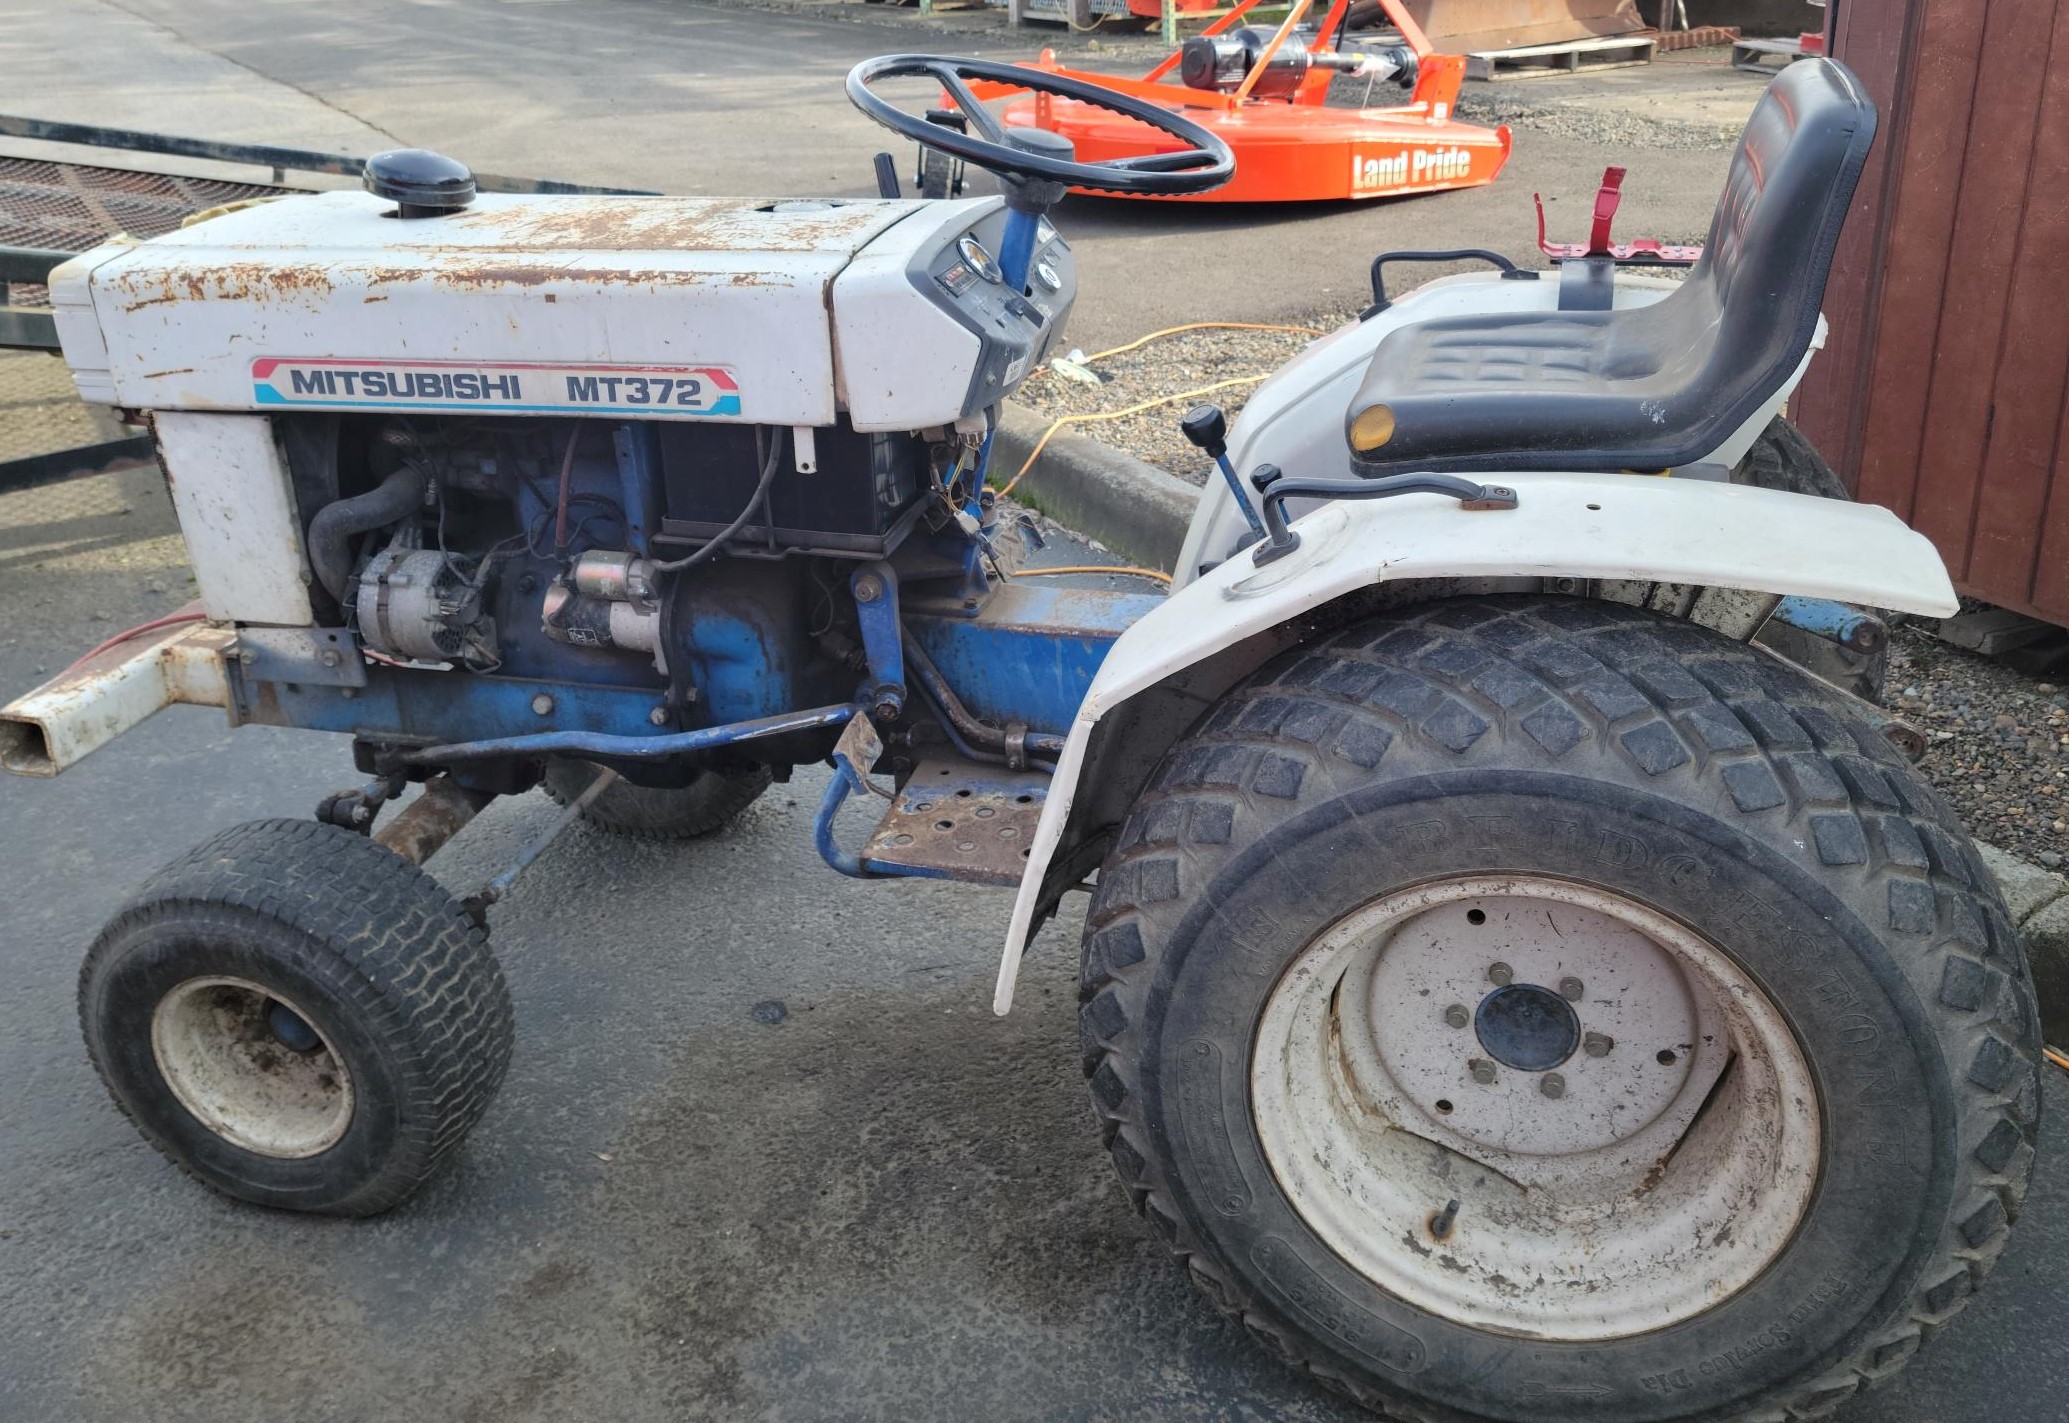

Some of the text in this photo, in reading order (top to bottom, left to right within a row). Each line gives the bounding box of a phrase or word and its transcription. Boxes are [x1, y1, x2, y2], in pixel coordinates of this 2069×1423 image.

[1353, 147, 1471, 189] Land Pride
[291, 370, 702, 405] MITSUBISHI MT372
[1395, 813, 1909, 1170] BRIDGESTONE
